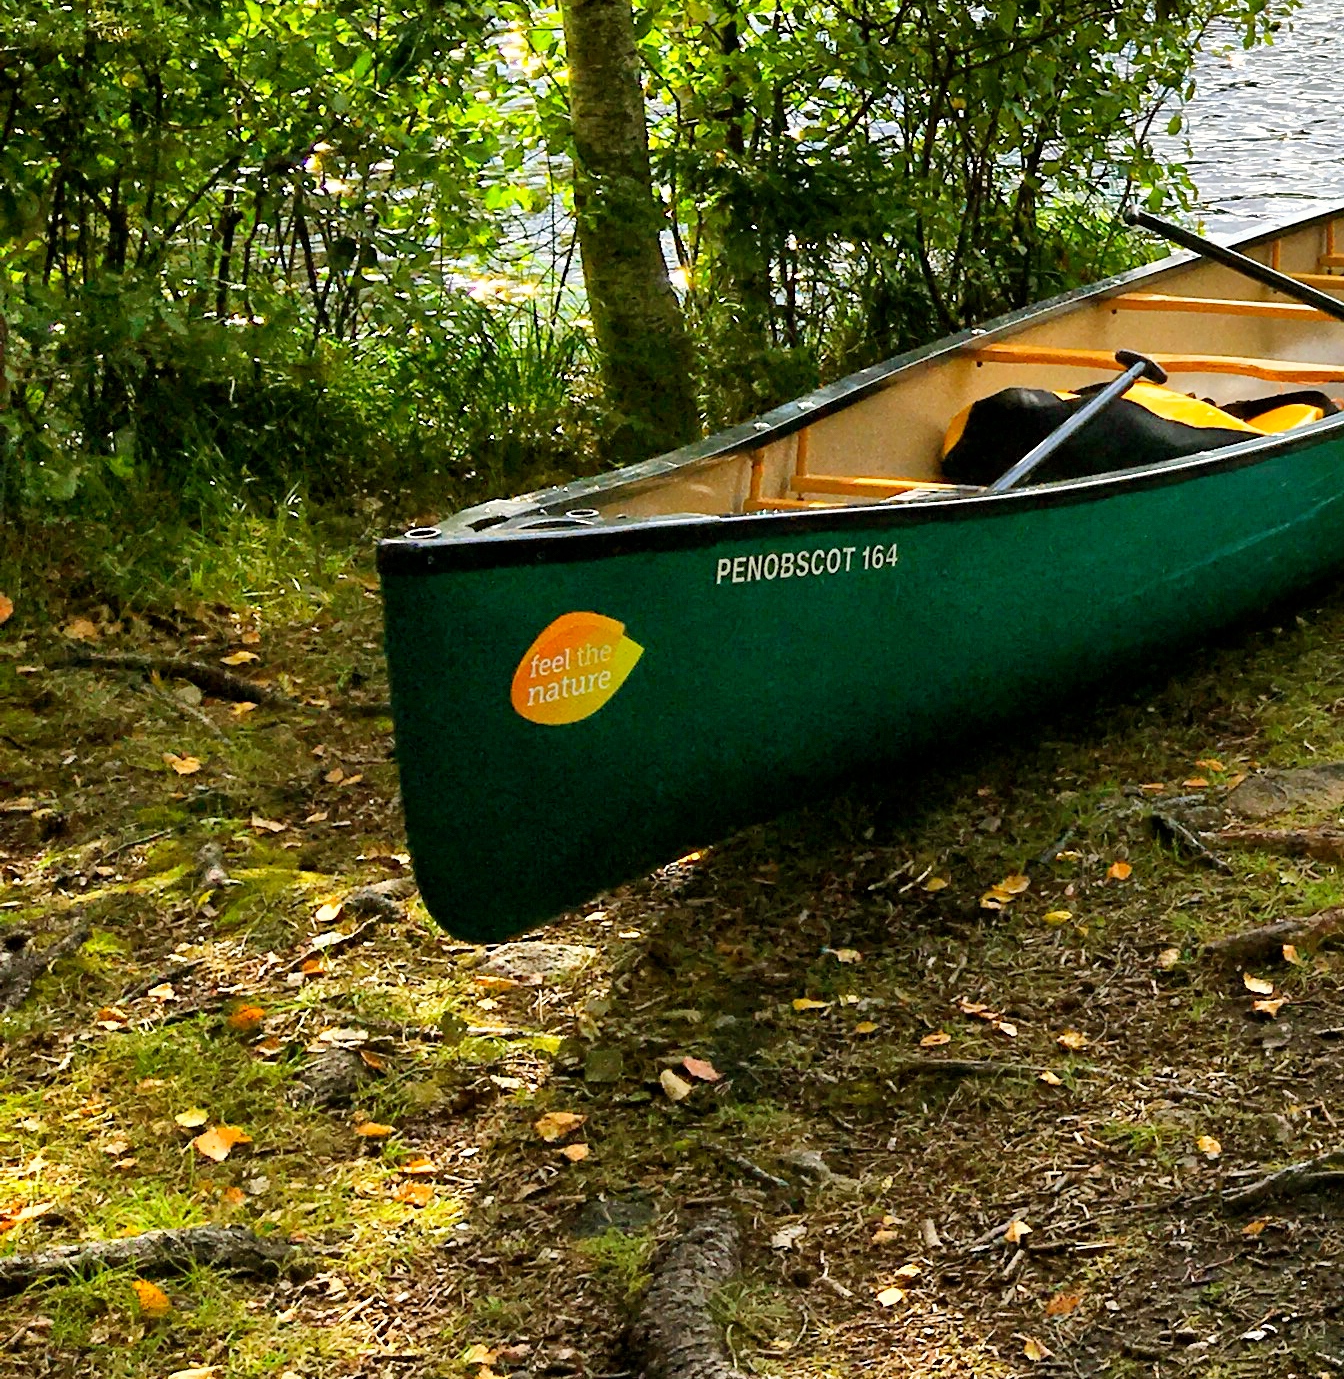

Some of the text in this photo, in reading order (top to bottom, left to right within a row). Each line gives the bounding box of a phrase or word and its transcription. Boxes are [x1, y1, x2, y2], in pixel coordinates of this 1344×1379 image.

[716, 543, 898, 584] PENOBSCOT 164
[530, 643, 612, 678] feel the
[527, 670, 611, 706] nature
